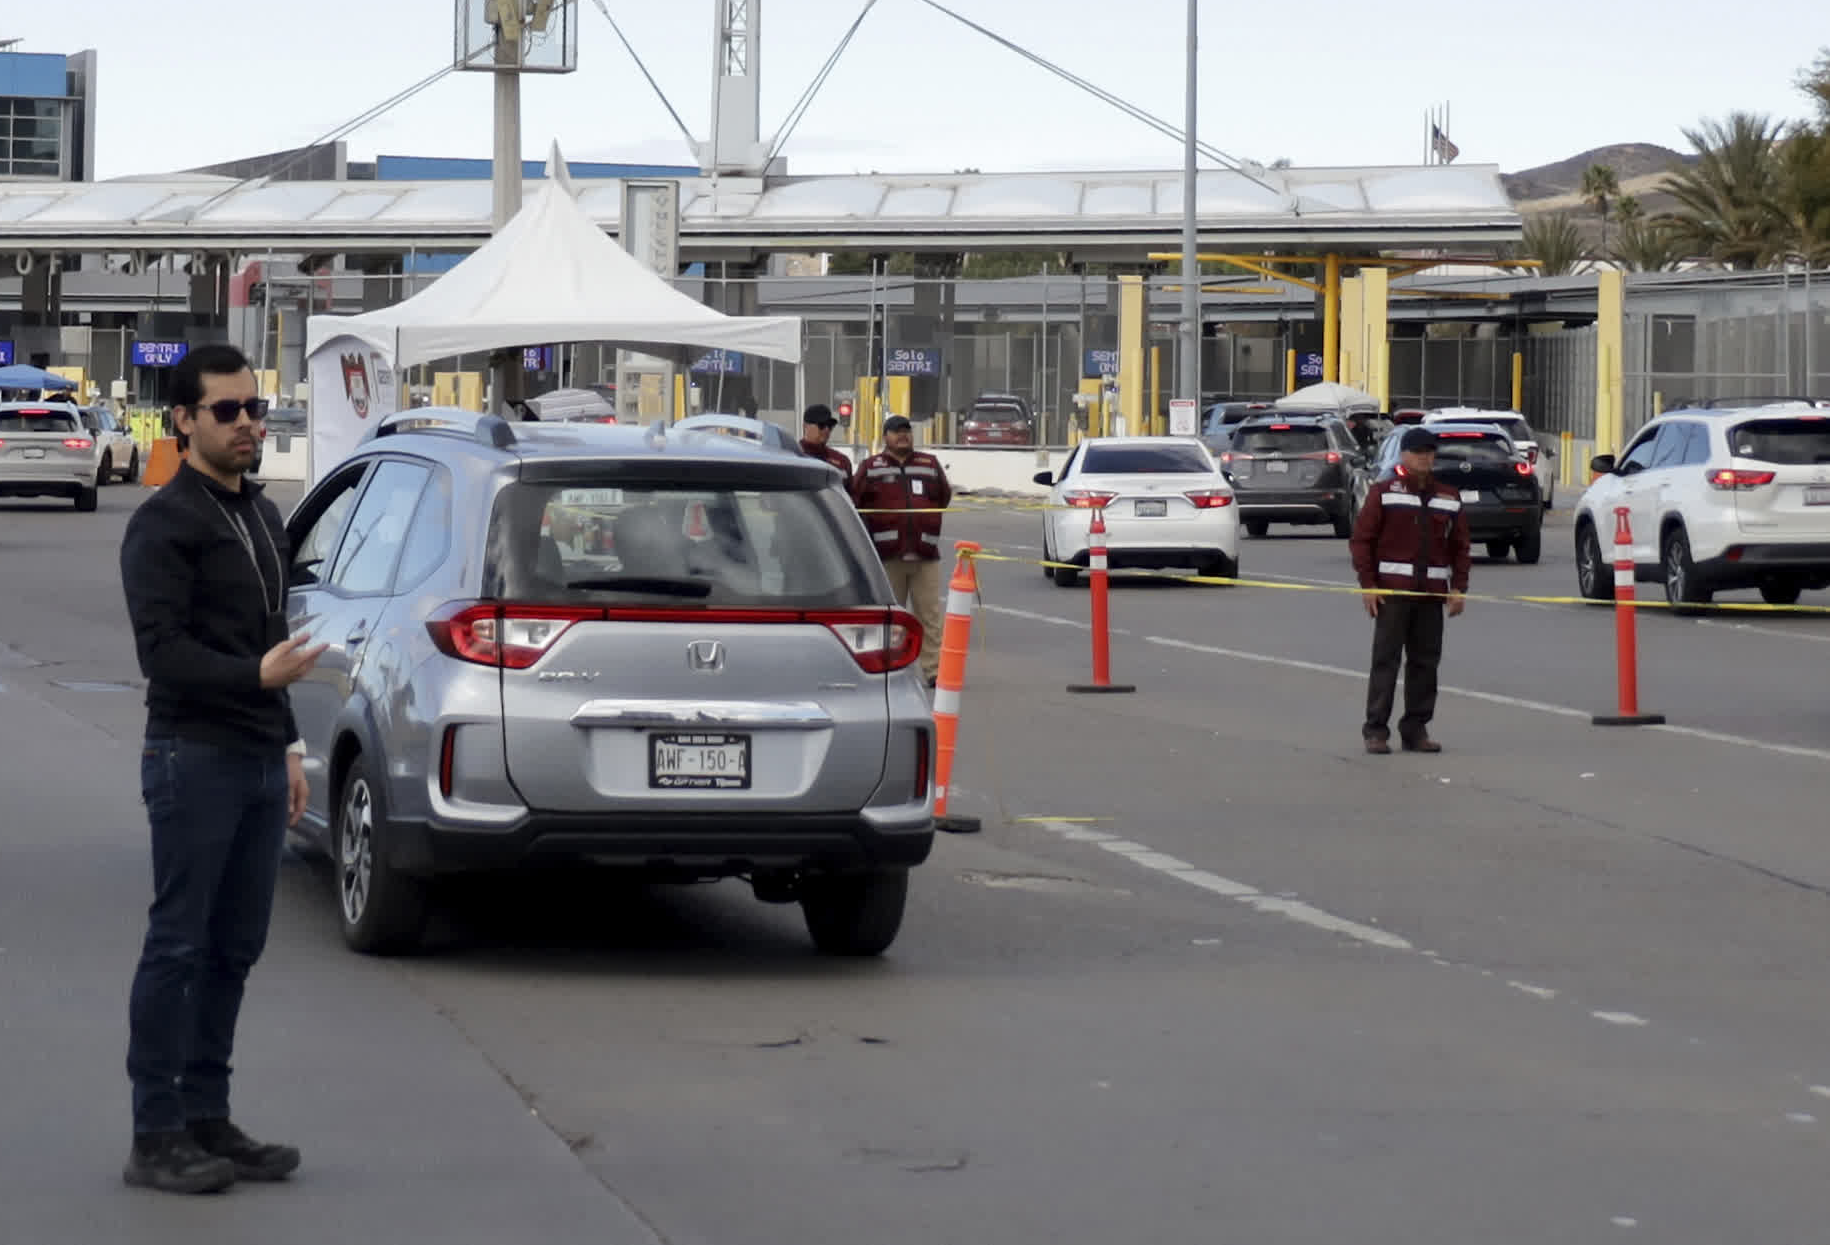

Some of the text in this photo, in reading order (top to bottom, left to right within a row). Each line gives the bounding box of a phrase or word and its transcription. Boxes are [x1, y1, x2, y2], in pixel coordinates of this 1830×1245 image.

[16, 250, 63, 277] OF
[138, 343, 179, 353] SENTRI
[145, 353, 173, 363] ONLY
[894, 349, 925, 361] Solo
[1308, 353, 1323, 365] So
[888, 360, 932, 372] SENTRI
[1300, 364, 1323, 376] SEN
[655, 747, 747, 772] AWF-150-A
